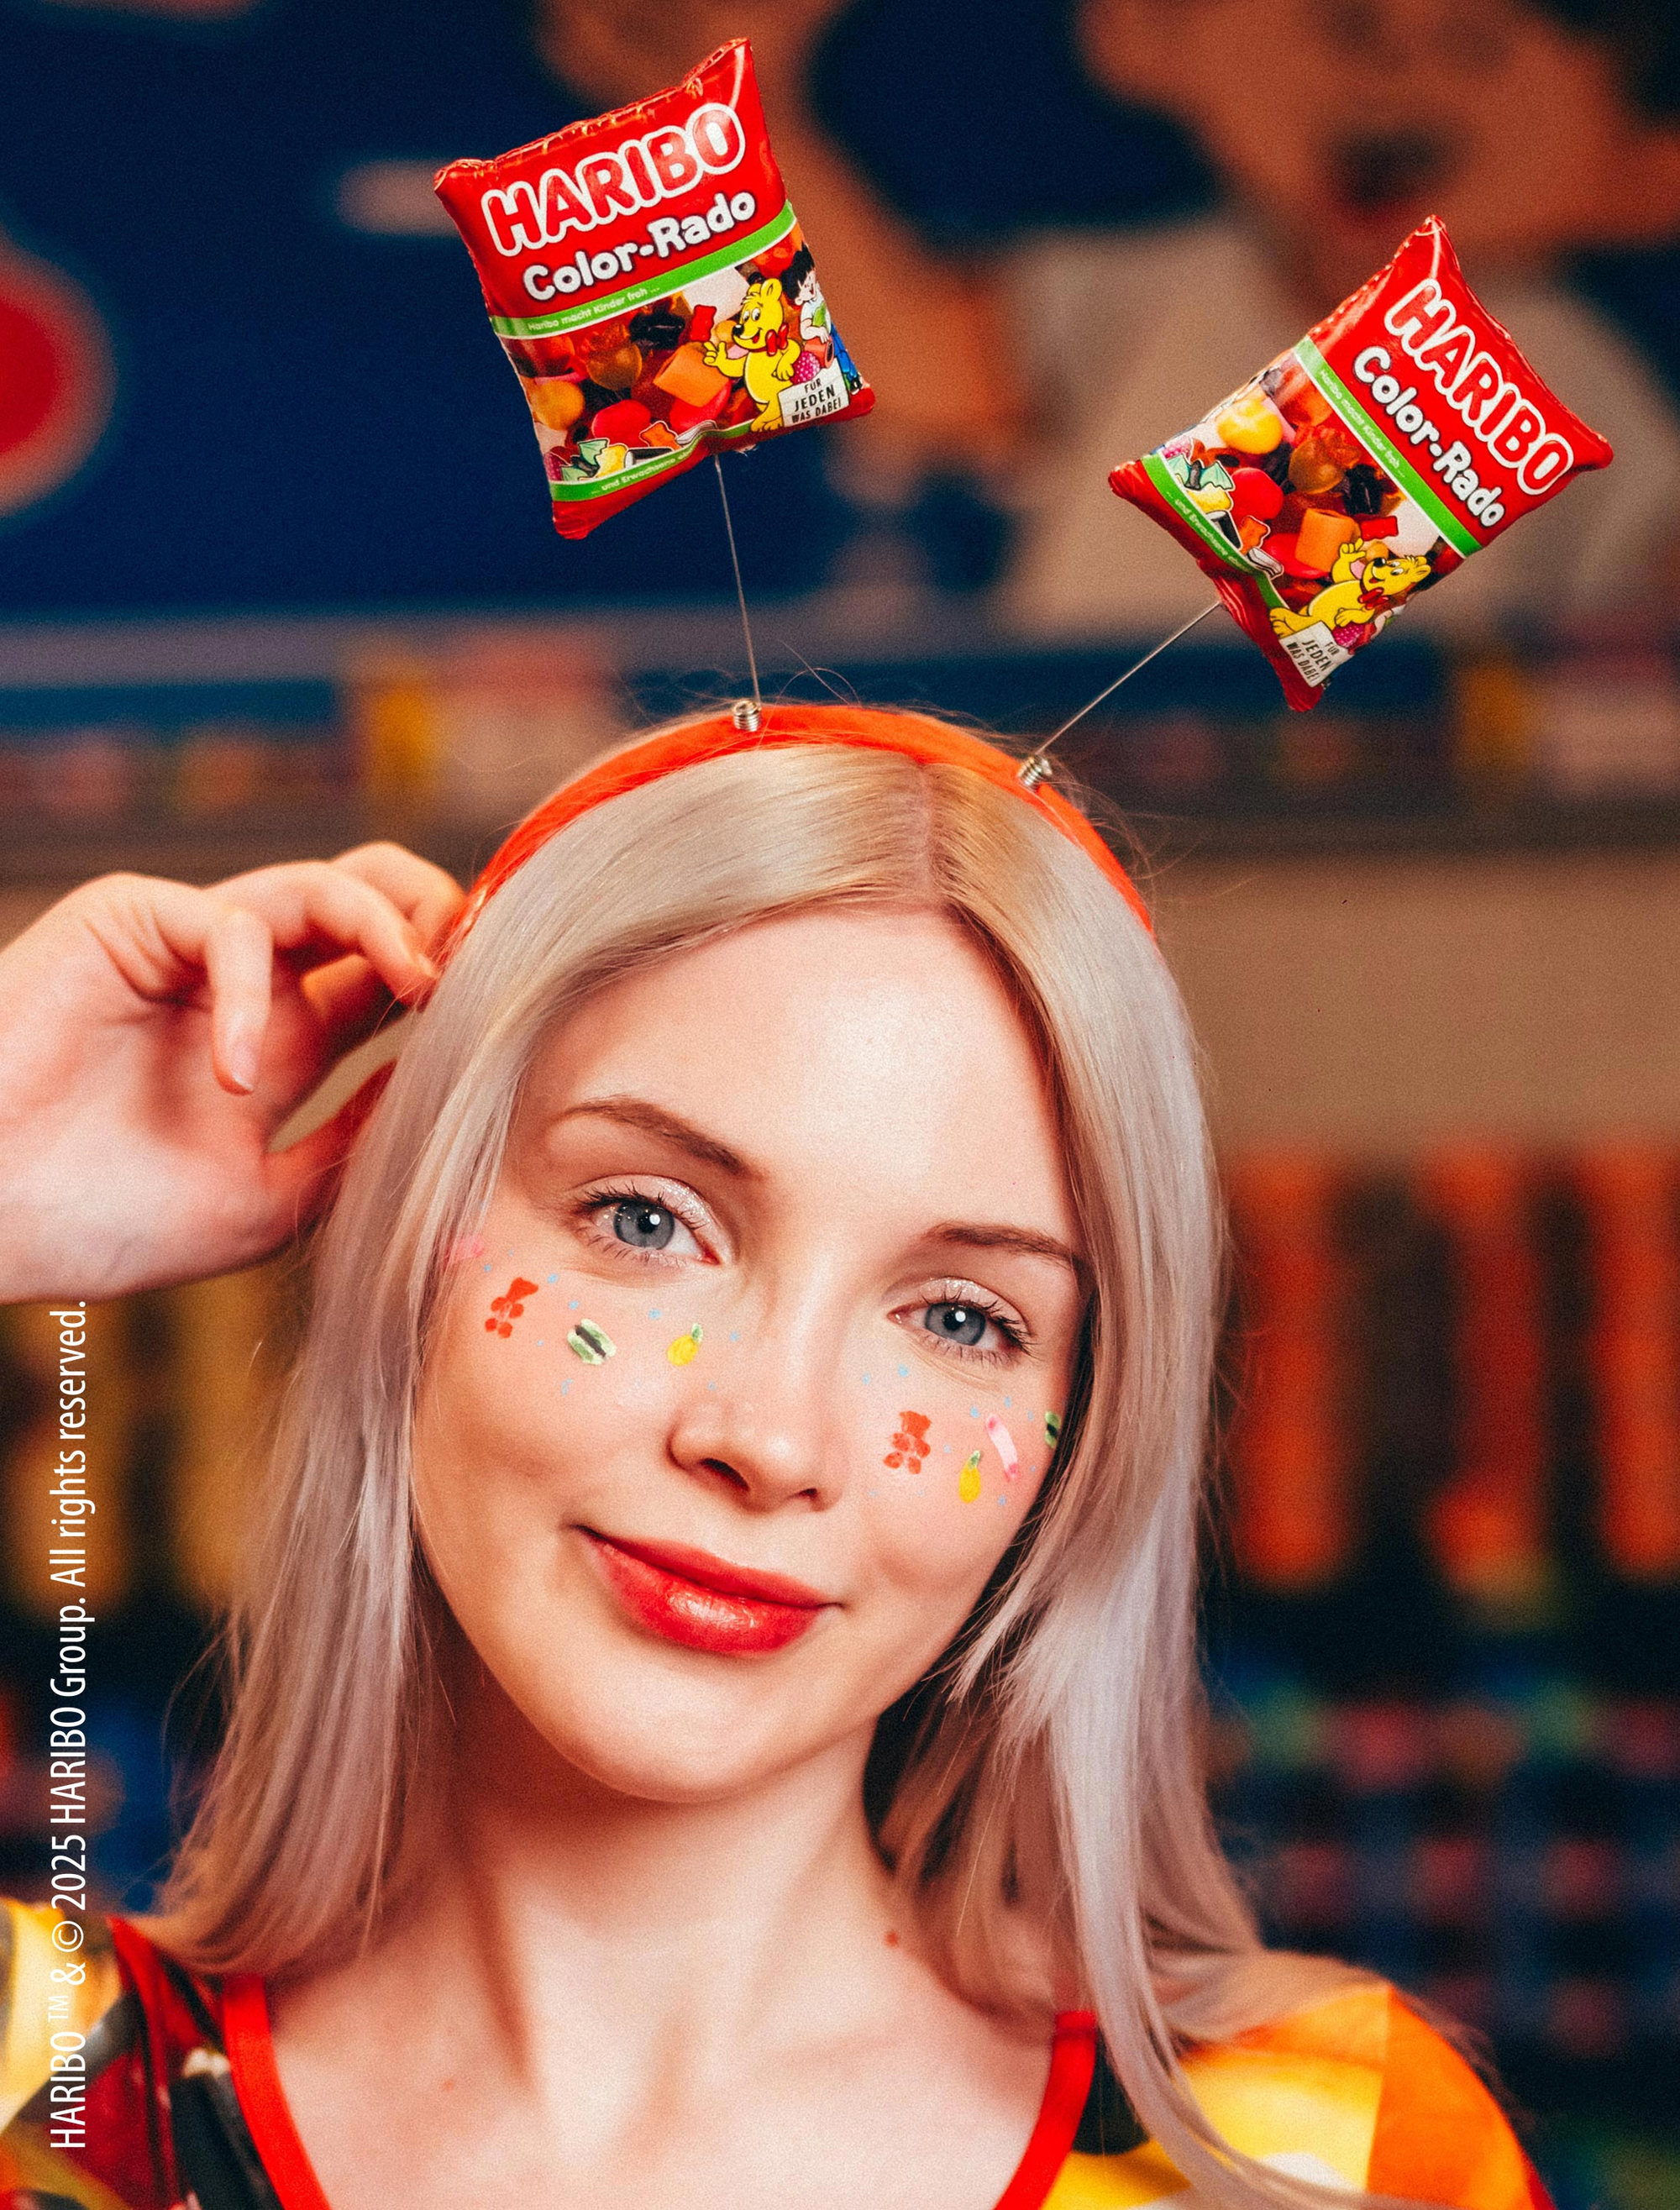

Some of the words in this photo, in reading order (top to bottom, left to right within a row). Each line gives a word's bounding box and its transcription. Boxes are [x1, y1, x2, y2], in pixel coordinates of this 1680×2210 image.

[481, 102, 746, 256] HARIBO
[522, 191, 756, 301] Color-Rado
[561, 307, 592, 324] macht
[593, 296, 626, 313] Kinder
[627, 287, 648, 302] froh
[795, 384, 835, 412] JEDEN
[1383, 278, 1574, 496] HARIBO
[791, 410, 811, 423] WAS
[815, 396, 842, 417] DABEI
[1353, 346, 1506, 528] Color-Rado
[601, 479, 620, 491] und
[1286, 642, 1305, 659] WAS
[1301, 639, 1332, 671] JEDEN
